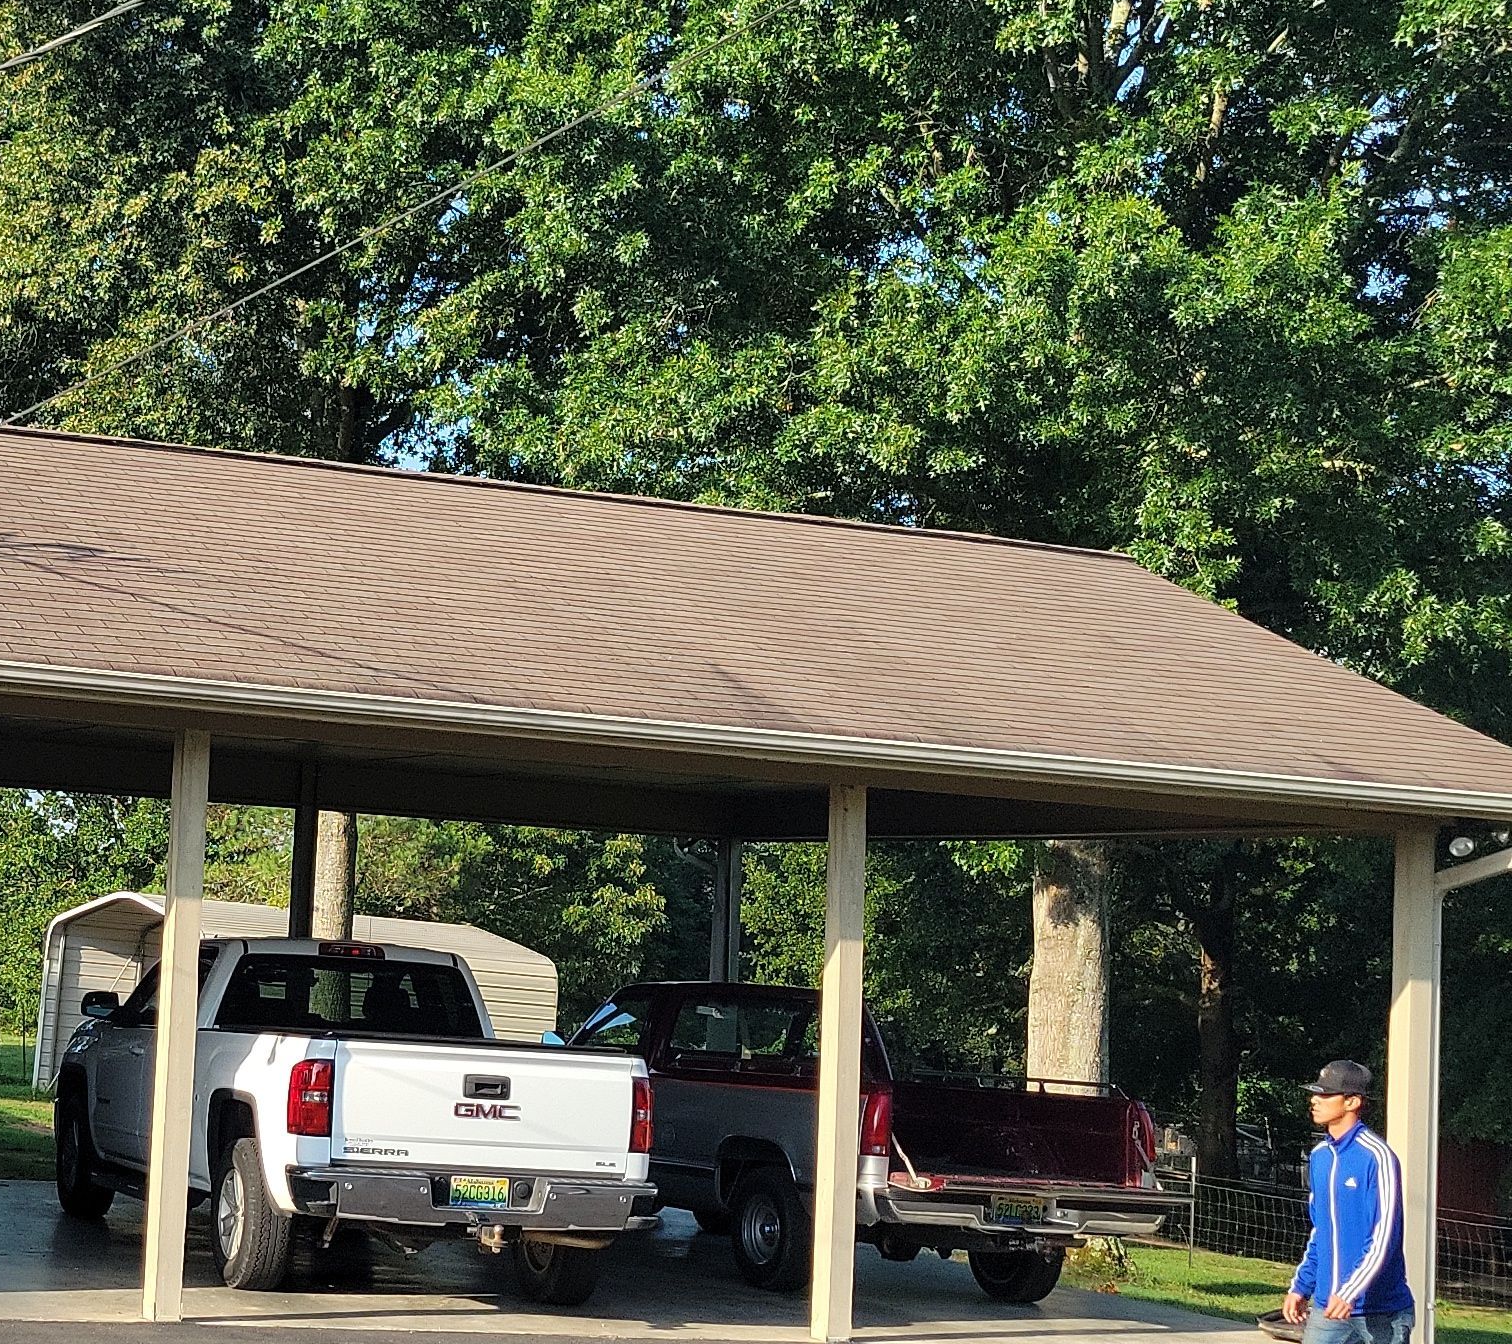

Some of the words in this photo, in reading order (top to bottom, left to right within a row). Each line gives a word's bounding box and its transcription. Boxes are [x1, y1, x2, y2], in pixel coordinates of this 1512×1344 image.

[454, 1102, 521, 1121] GMC
[343, 1146, 409, 1156] SIERRA
[455, 1184, 505, 1202] 52CG316
